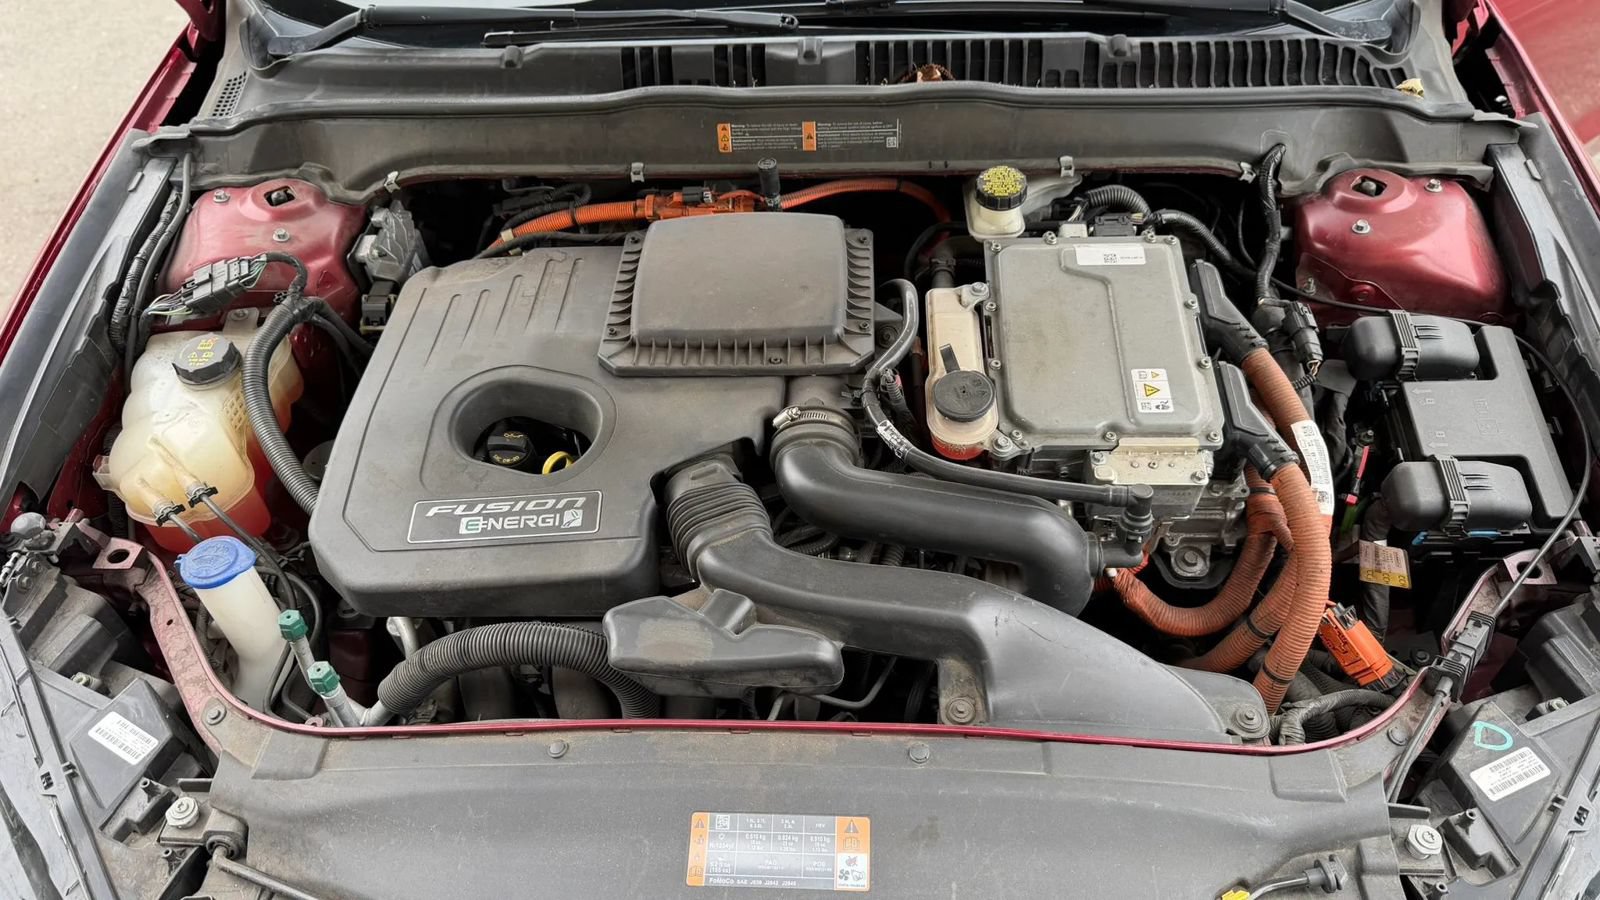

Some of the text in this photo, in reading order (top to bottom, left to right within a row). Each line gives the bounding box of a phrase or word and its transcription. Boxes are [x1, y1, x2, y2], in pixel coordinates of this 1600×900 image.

[425, 497, 587, 517] FUSION
[459, 513, 560, 534] ENERGI
[709, 877, 735, 885] FoMoCo
